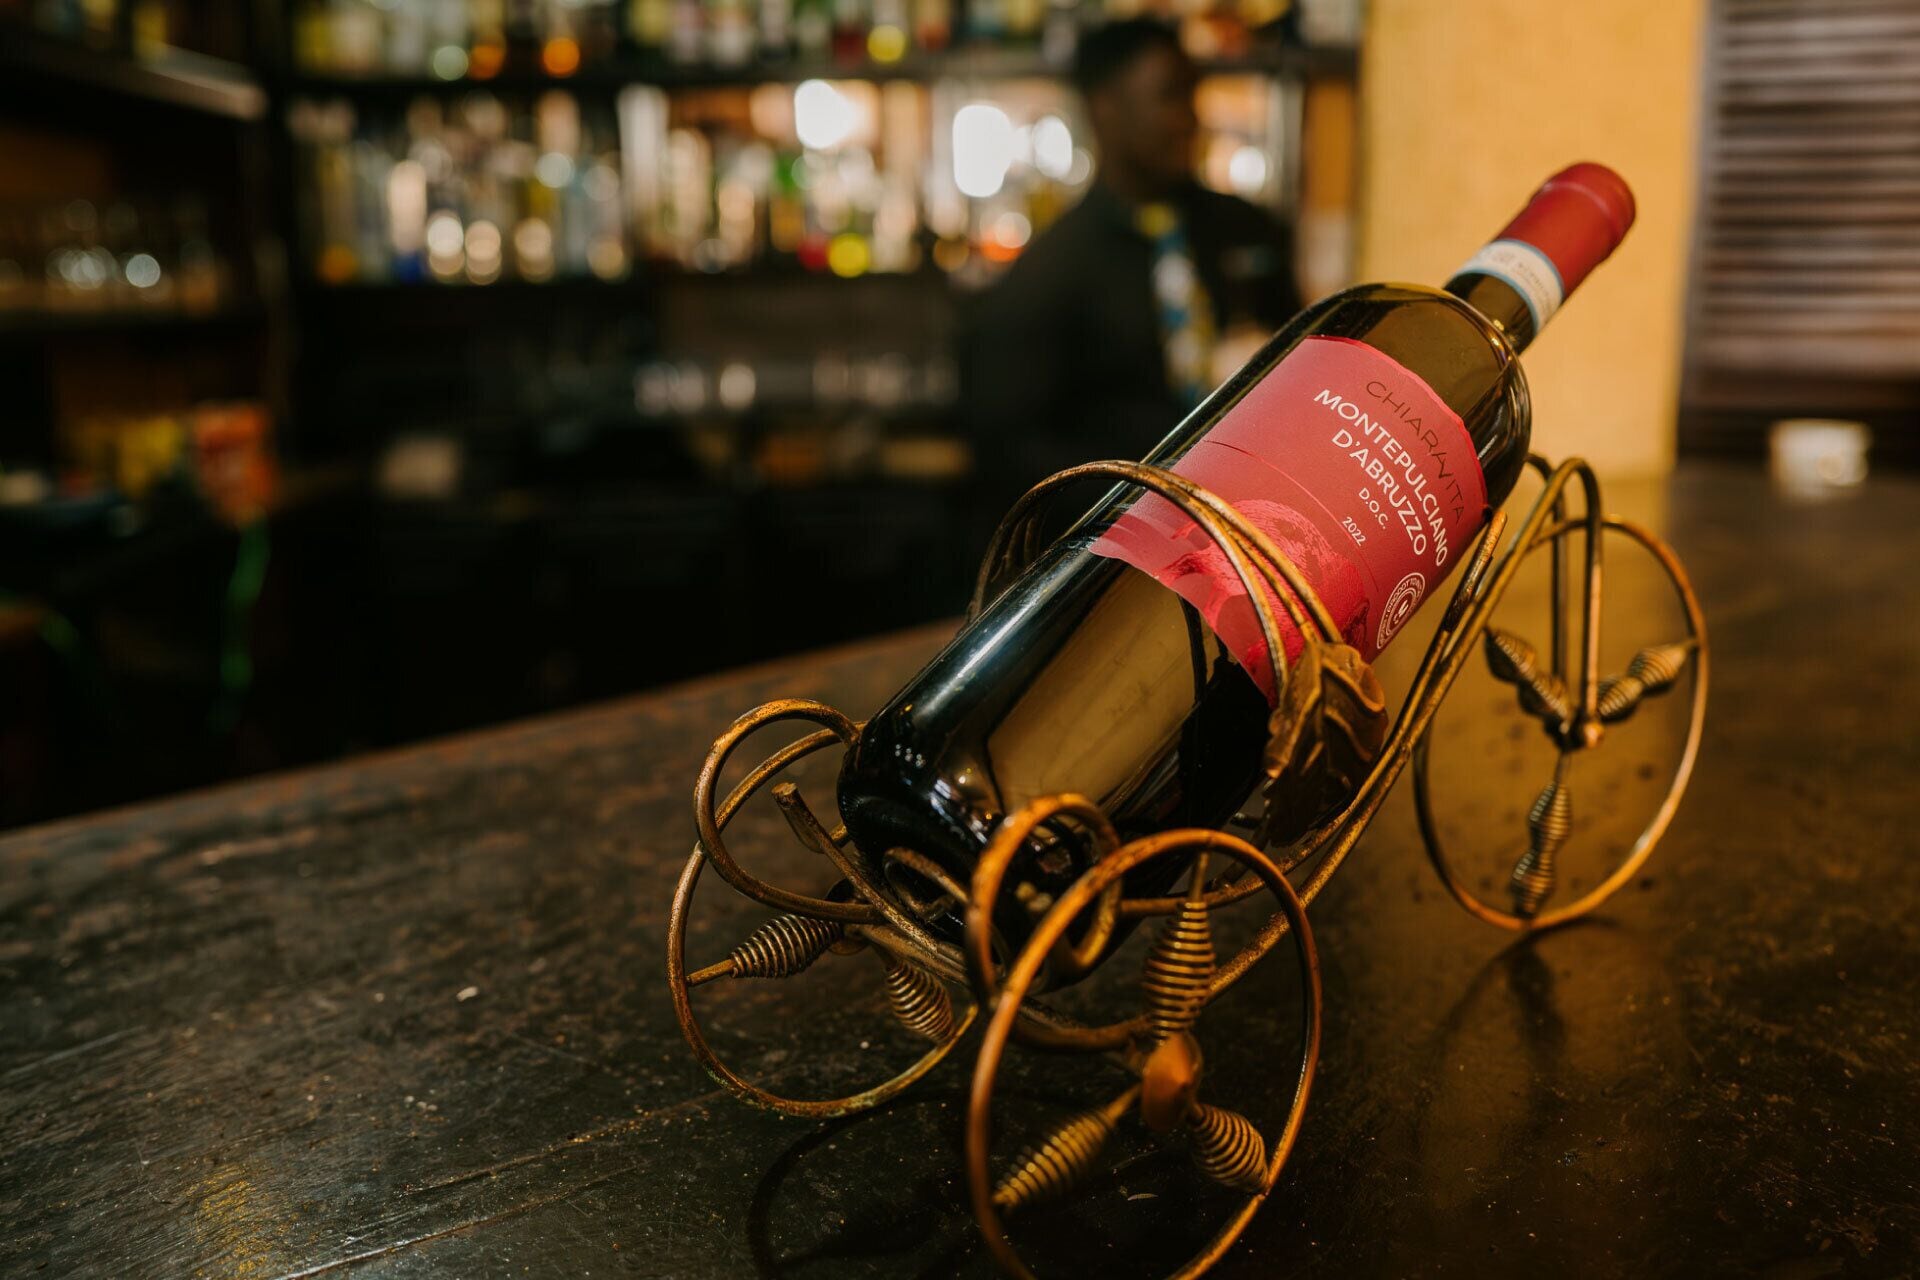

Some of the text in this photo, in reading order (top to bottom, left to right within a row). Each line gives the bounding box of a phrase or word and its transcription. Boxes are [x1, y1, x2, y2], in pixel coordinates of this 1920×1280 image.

[1314, 389, 1447, 567] MONTEPULCIANO
[1331, 429, 1427, 555] D'ABRUZZO
[1358, 487, 1389, 529] D.O.C.
[1341, 516, 1367, 547] 2022
